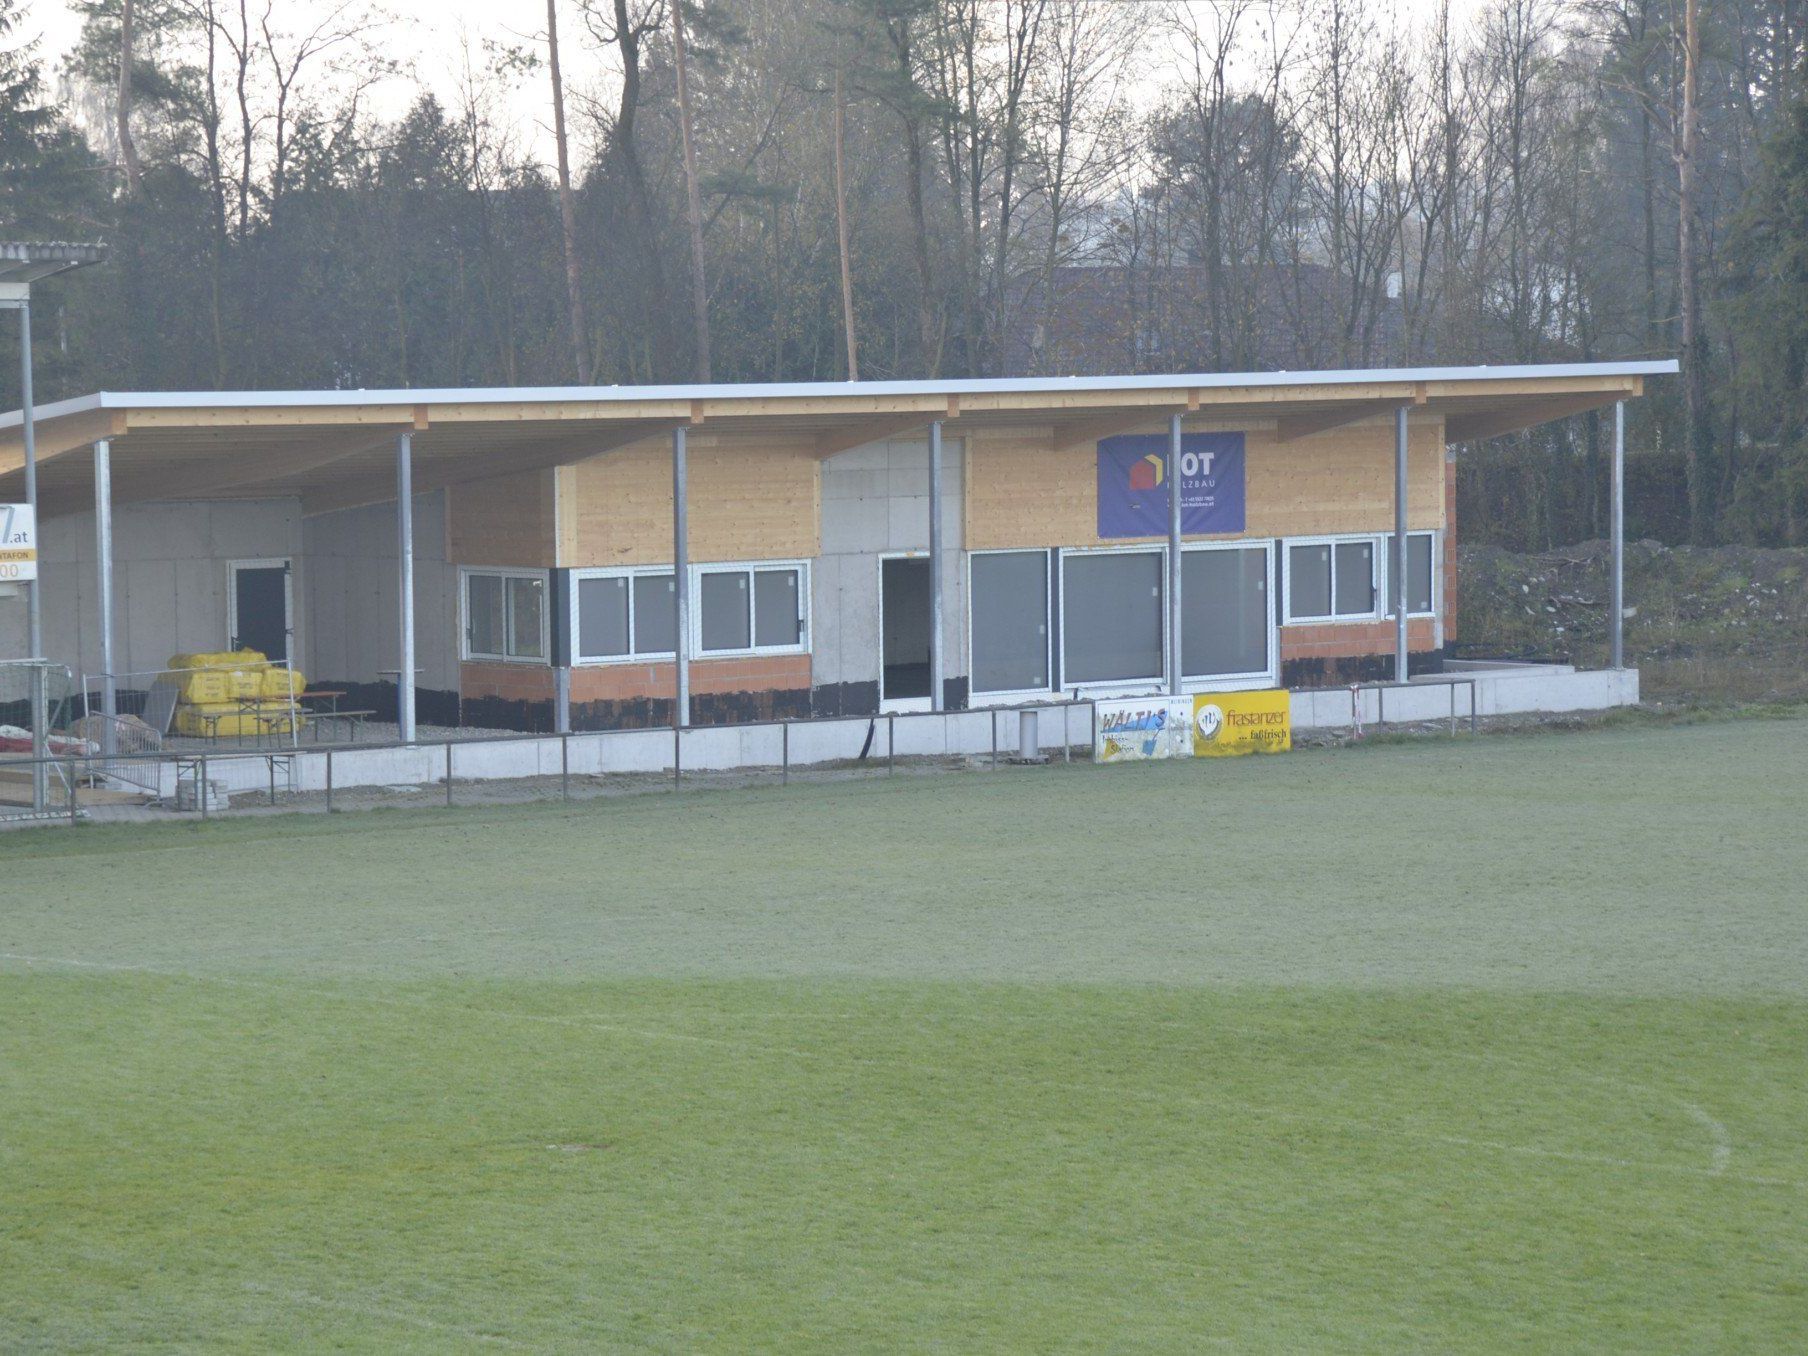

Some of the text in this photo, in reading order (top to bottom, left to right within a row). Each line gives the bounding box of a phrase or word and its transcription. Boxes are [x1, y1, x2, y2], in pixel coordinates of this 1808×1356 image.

[1167, 452, 1215, 477] OT
[1167, 480, 1215, 489] LZBAU
[0, 551, 29, 560] TAFON
